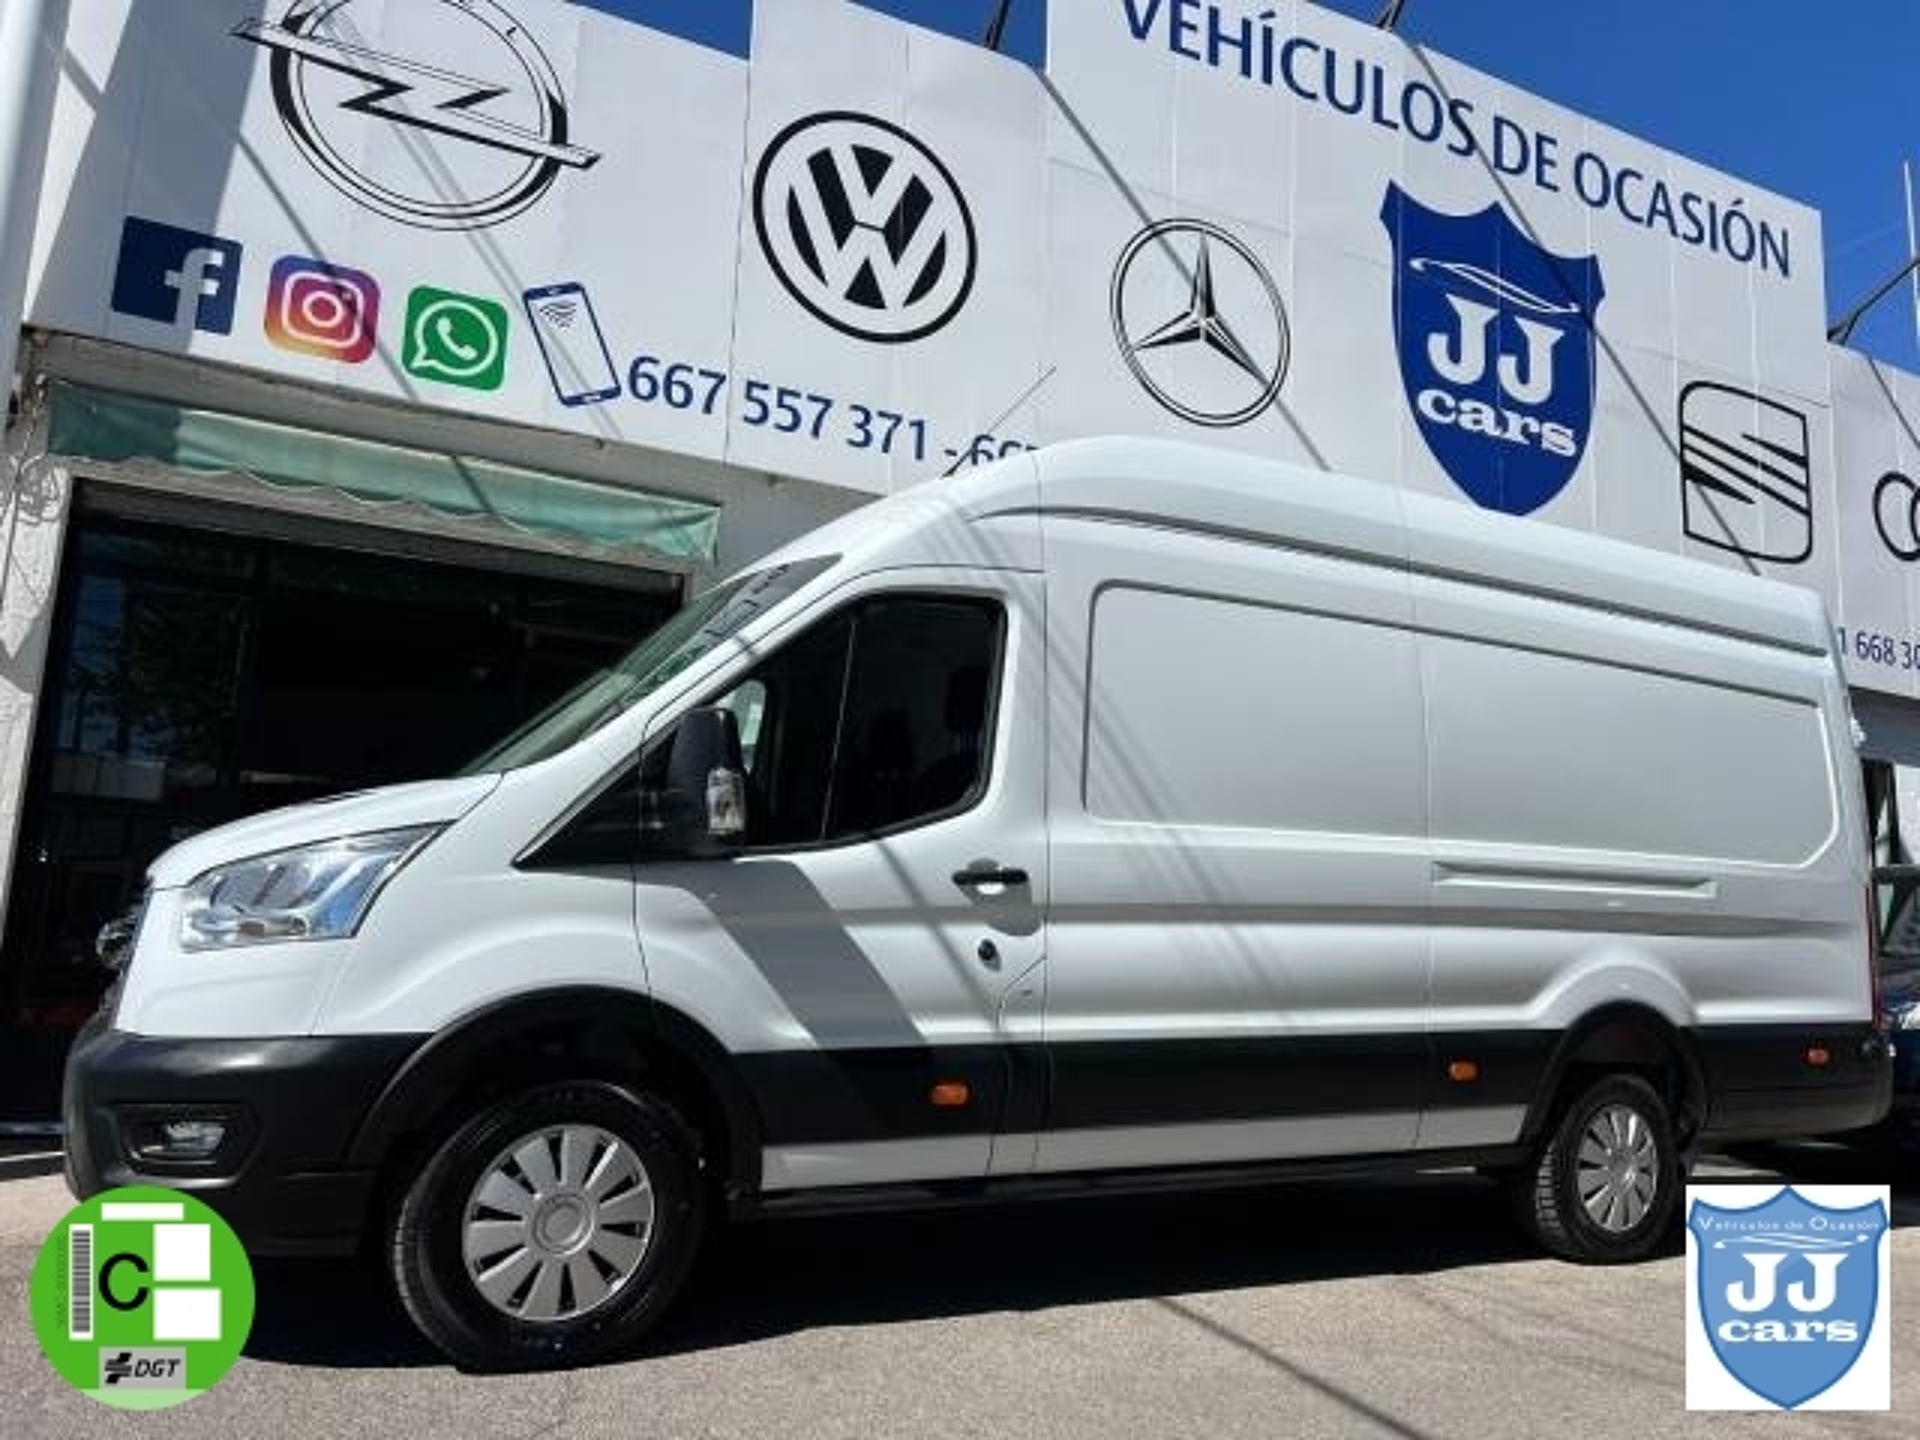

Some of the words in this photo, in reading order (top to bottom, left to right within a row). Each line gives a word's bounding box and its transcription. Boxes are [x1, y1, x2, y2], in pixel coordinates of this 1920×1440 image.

[1122, 0, 1476, 158] VEHÍCULOS
[1492, 114, 1560, 192] DE
[1573, 150, 1791, 278] OCASIÓN
[1427, 293, 1565, 404] JJ
[628, 355, 727, 414] 667
[743, 380, 834, 440] 557
[846, 404, 926, 461] 371
[1417, 389, 1577, 457] cars
[1856, 630, 1897, 666] 668
